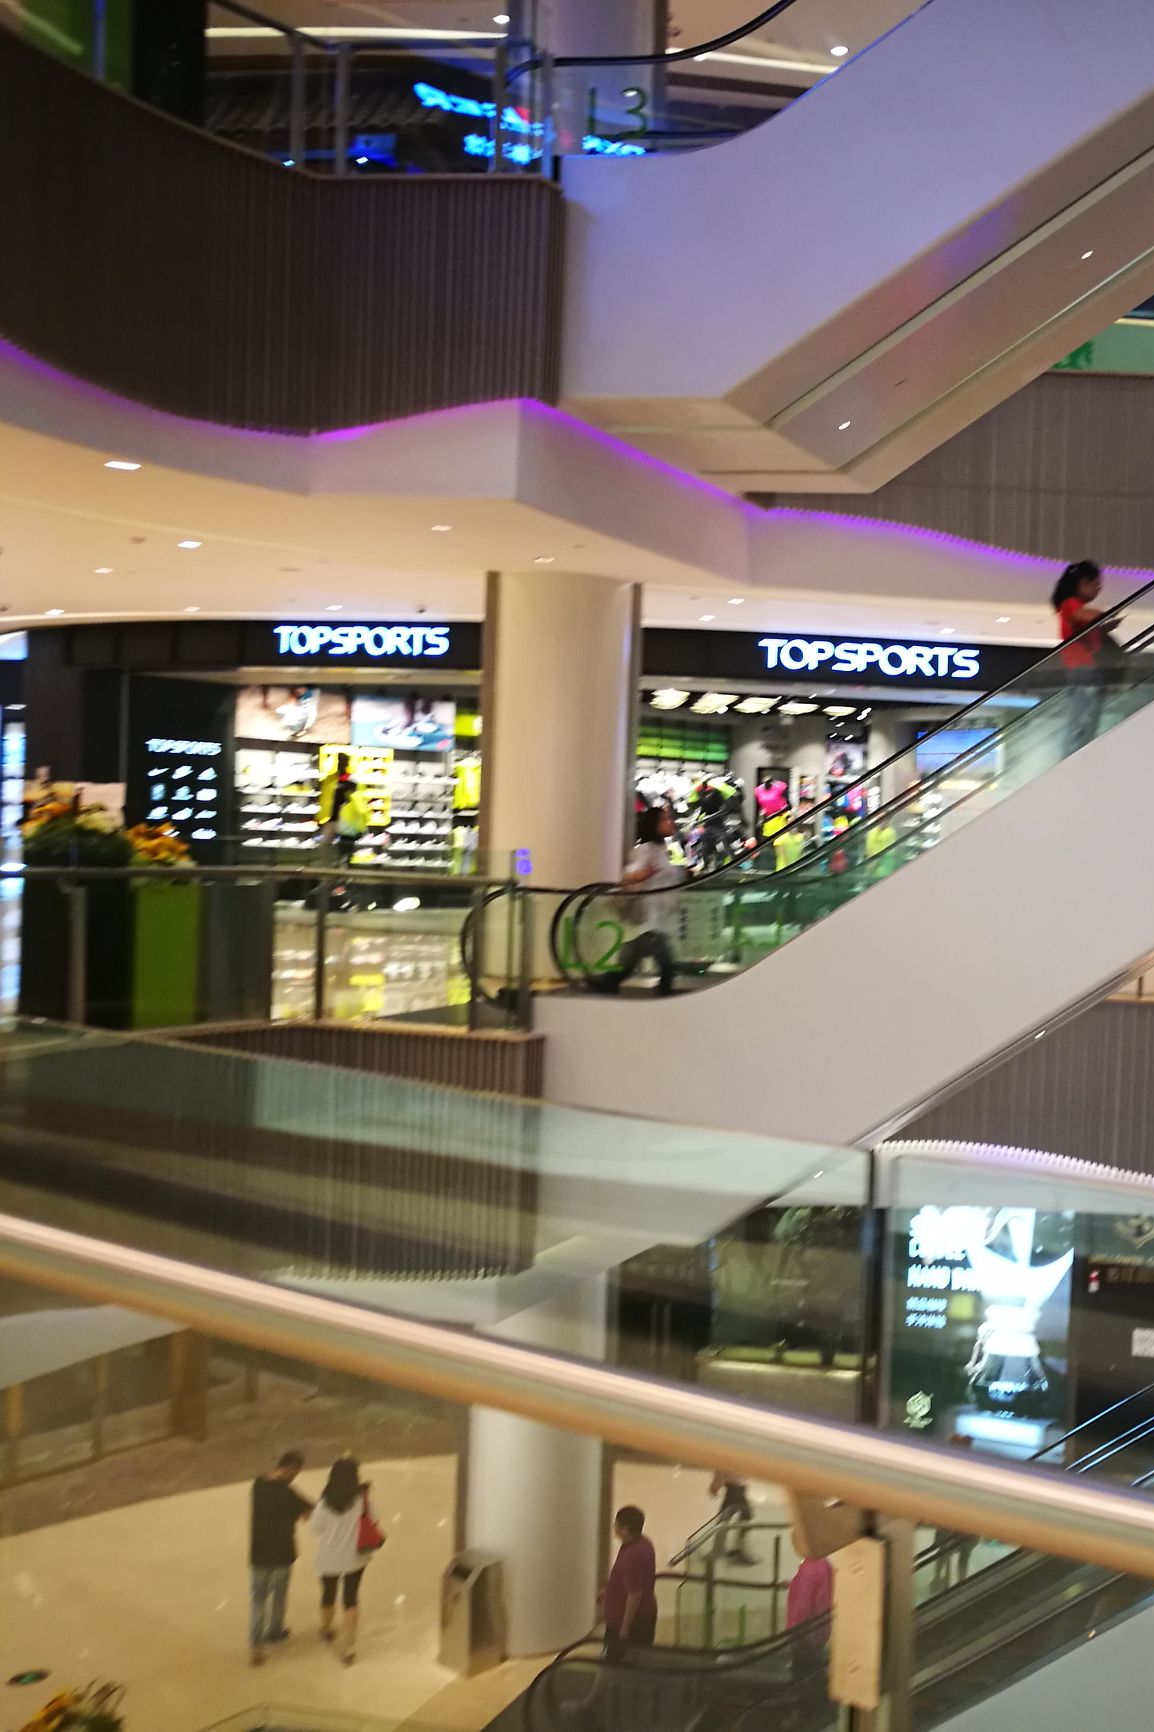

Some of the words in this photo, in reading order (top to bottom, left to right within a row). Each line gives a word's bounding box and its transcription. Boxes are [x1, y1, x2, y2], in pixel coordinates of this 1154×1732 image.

[586, 87, 647, 138] L3
[273, 625, 450, 656] TOPSPORTS
[757, 638, 981, 678] TOPSPORTS
[556, 916, 625, 972] L2
